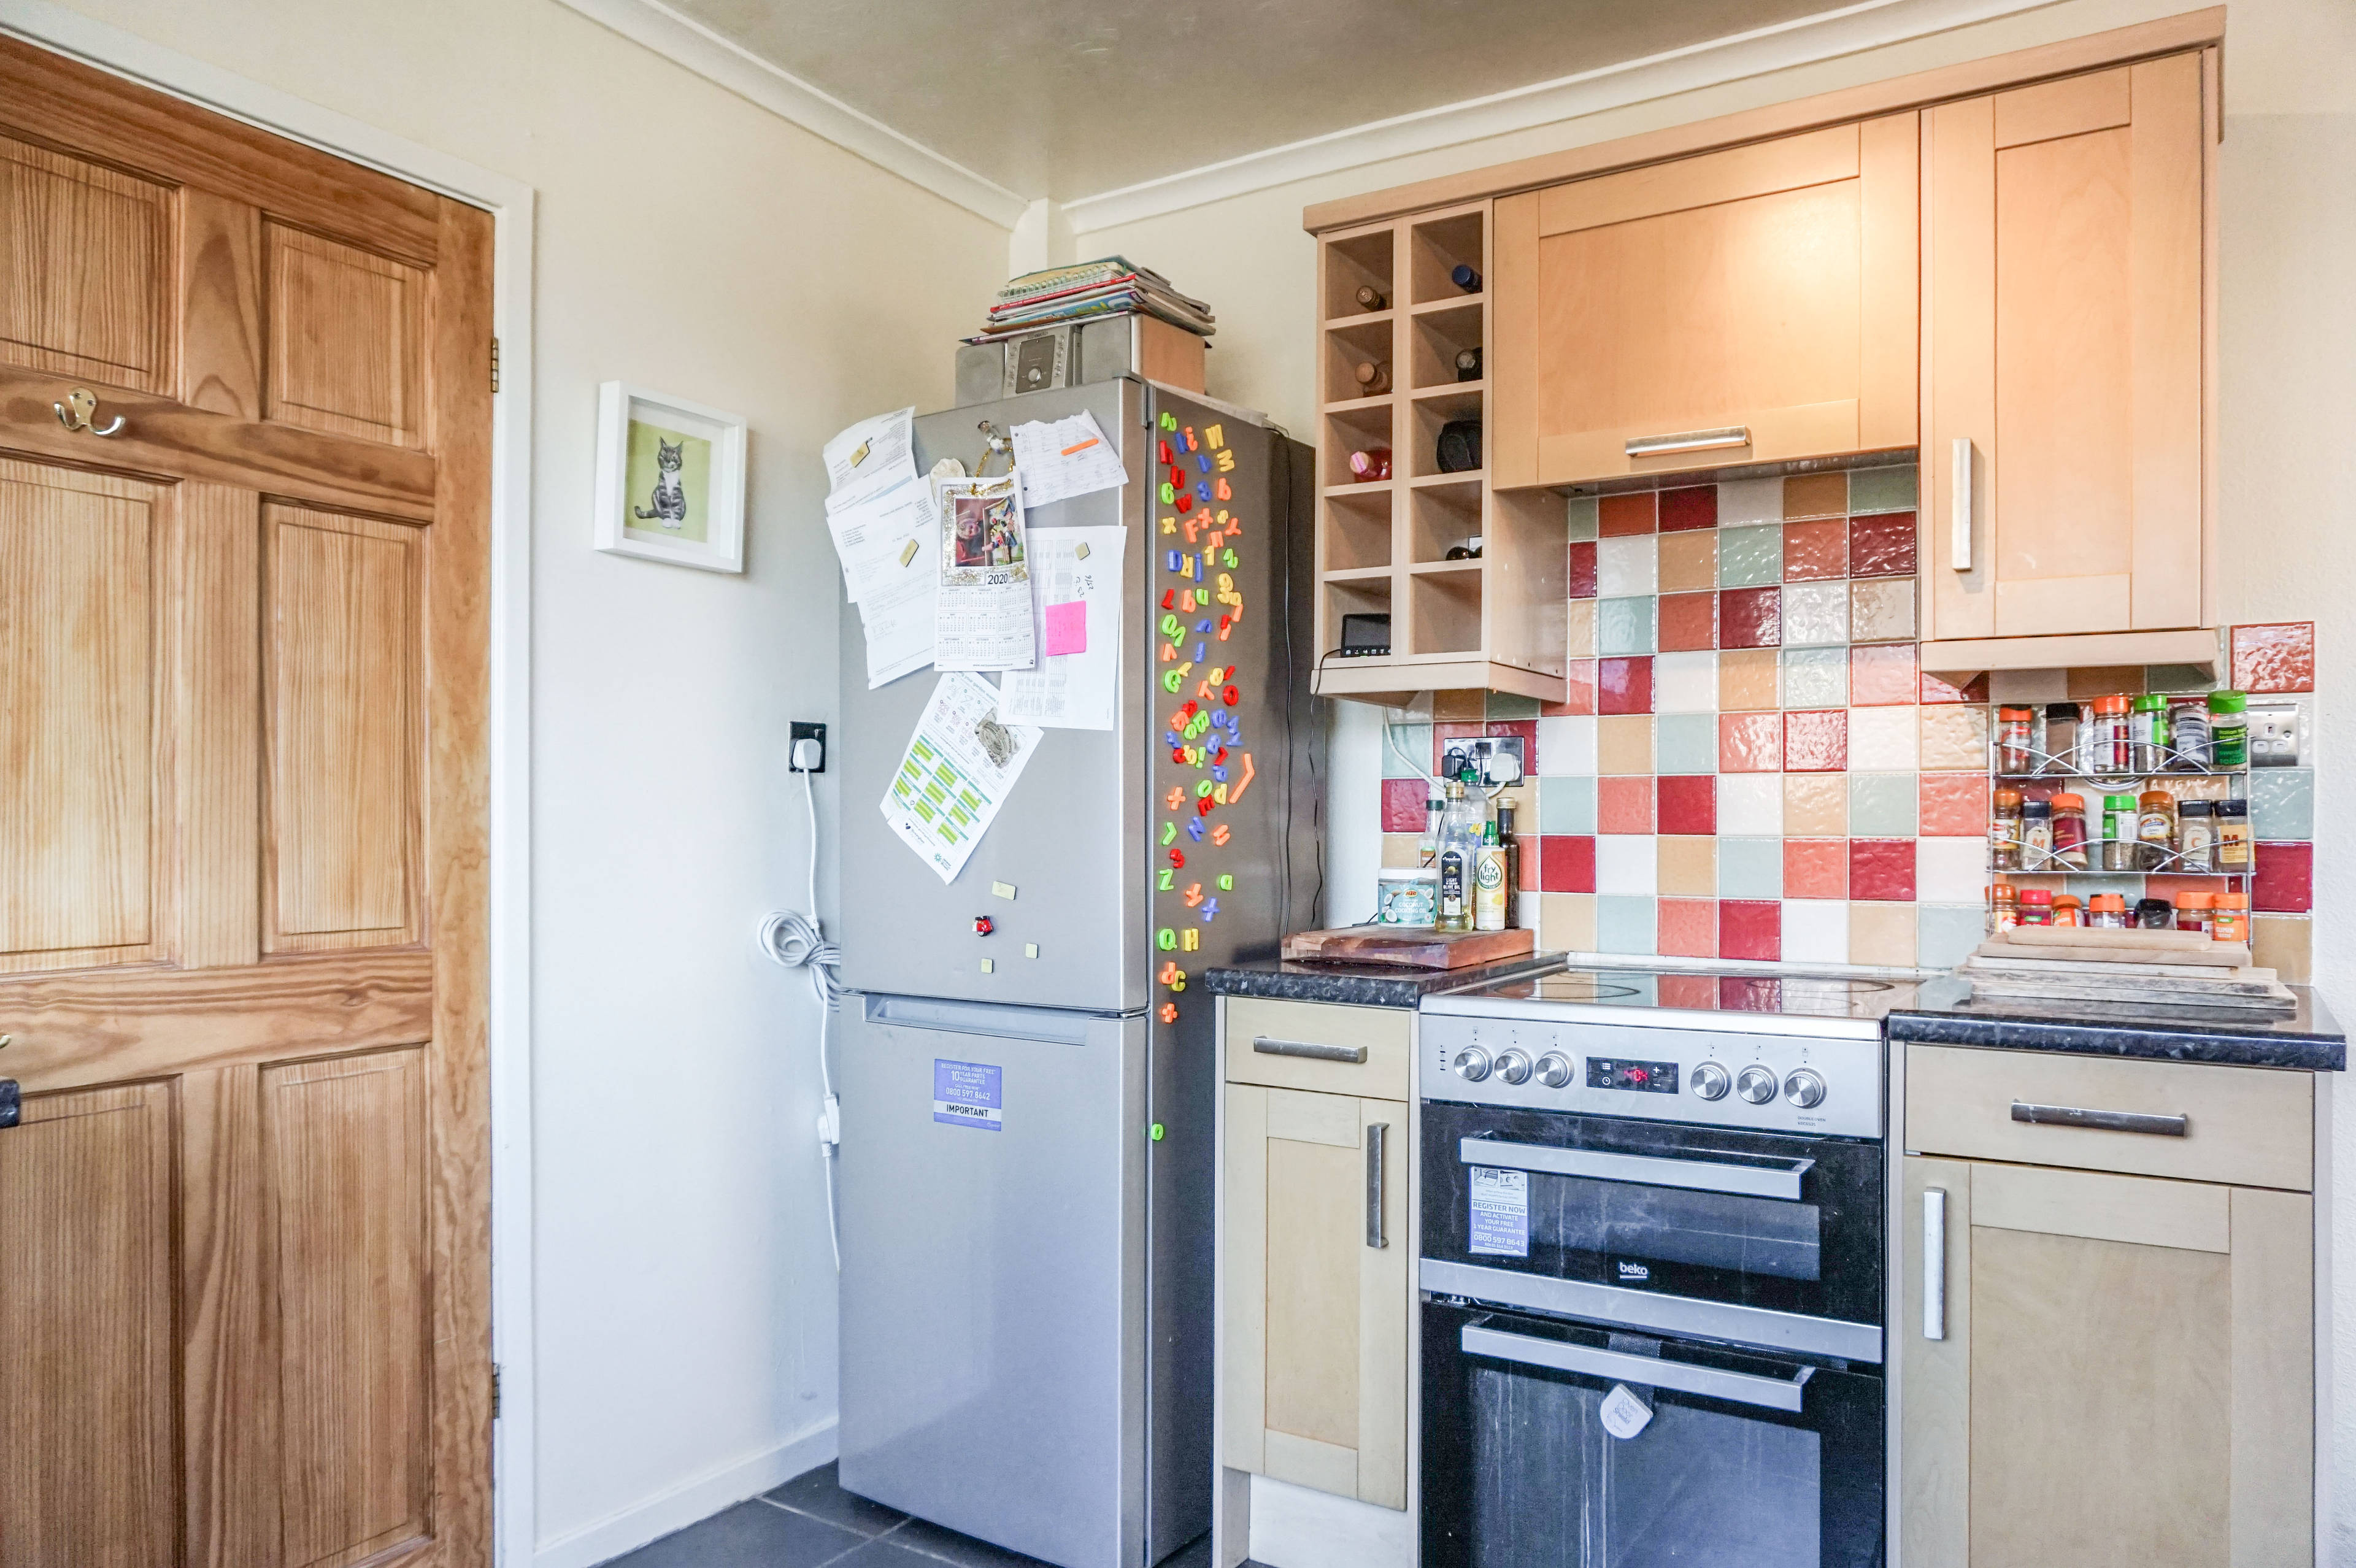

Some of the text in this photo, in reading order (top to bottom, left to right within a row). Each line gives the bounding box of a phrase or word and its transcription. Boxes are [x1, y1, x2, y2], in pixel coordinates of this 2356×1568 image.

[987, 573, 1008, 585] 2020
[1484, 864, 1496, 873] fry
[1480, 869, 1499, 883] light
[1159, 928, 1178, 951] Q
[1184, 928, 1199, 951] H
[951, 1070, 960, 1081] 10
[945, 1087, 961, 1096] 0800
[962, 1090, 973, 1098] 597
[974, 1091, 990, 1101] 8642
[946, 1104, 988, 1118] IMPORTANT
[1473, 1201, 1507, 1212] REGISTER
[1493, 1213, 1519, 1221] ACTIVATE
[1493, 1226, 1526, 1236] GUARANTEE
[1474, 1234, 1525, 1247] 0800 597 8643
[1620, 1261, 1648, 1275] beko
